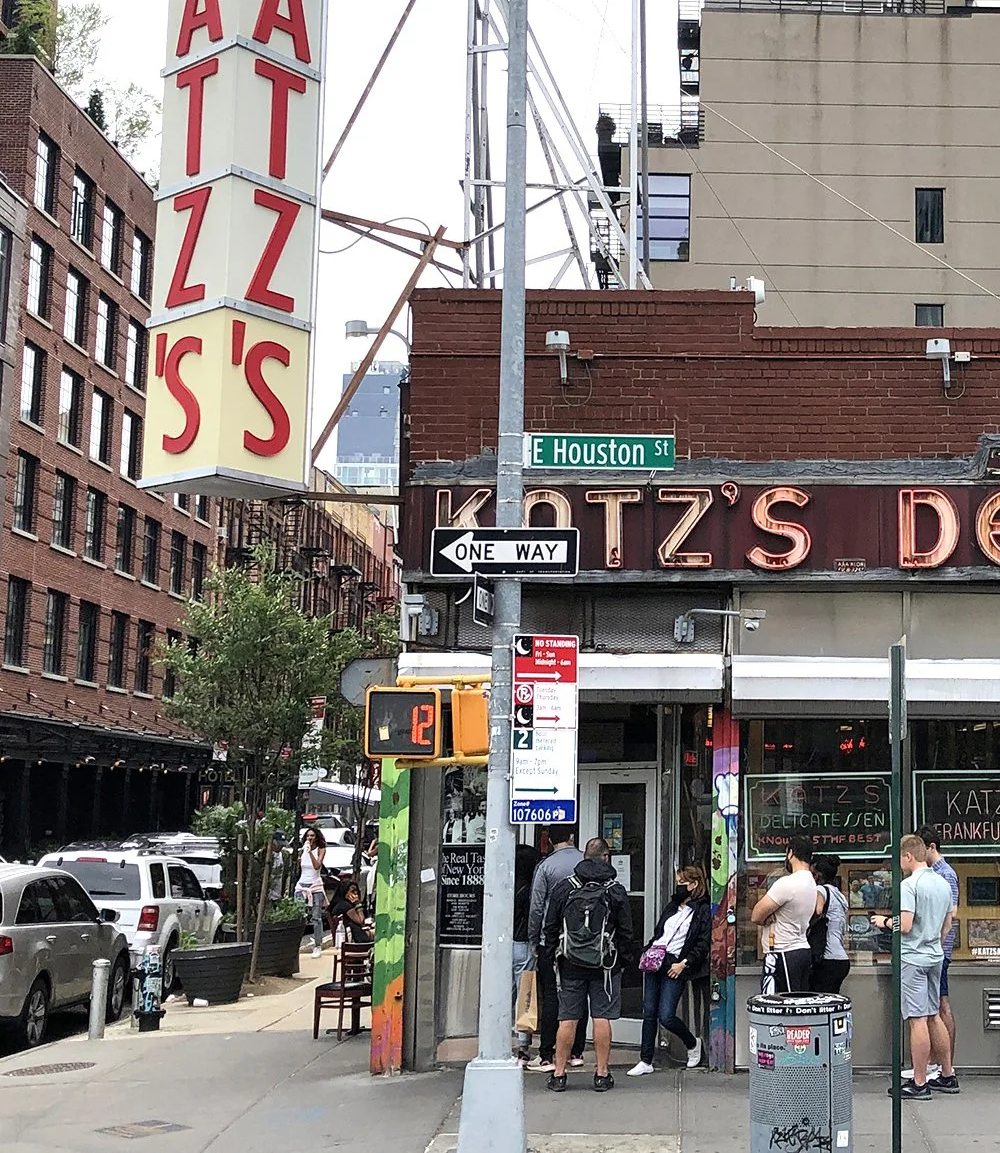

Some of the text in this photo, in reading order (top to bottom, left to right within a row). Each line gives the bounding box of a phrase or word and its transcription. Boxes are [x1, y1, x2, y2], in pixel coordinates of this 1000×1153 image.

[533, 438, 669, 465] E Houston St
[455, 543, 559, 561] ONE WAY
[546, 640, 576, 648] STANDING
[411, 704, 434, 745] 12
[518, 730, 529, 749] 2
[515, 767, 536, 776] Except
[513, 808, 552, 821] 107606
[760, 811, 886, 829] DELICATESSEN
[848, 833, 882, 843] BEST
[450, 852, 469, 864] Real
[470, 851, 486, 864] Tas
[466, 863, 485, 875] Yor
[441, 874, 485, 886] Since 1888
[786, 1029, 811, 1040] READER
